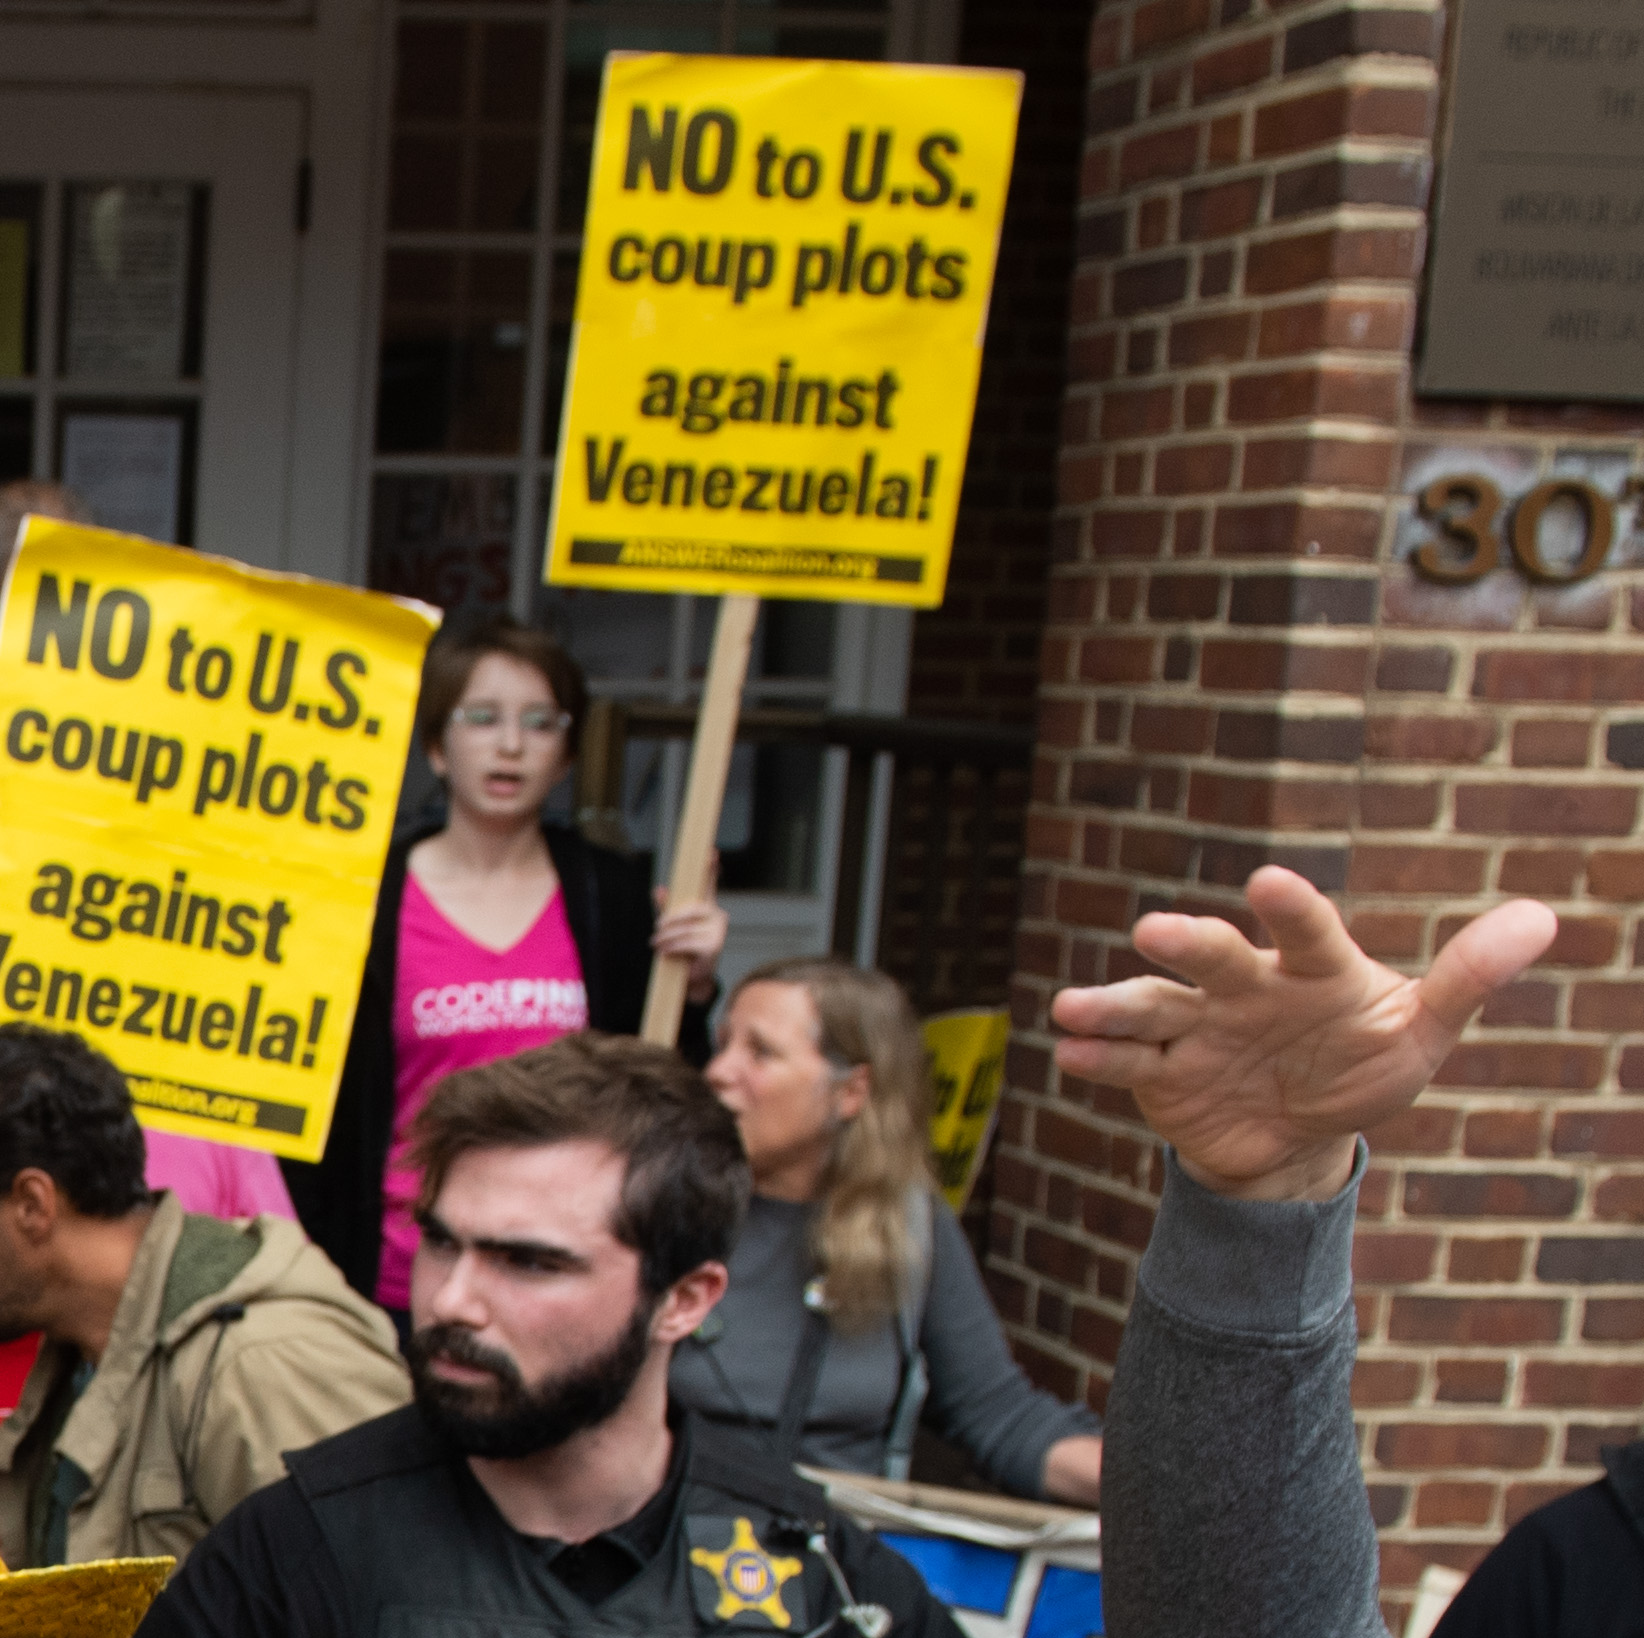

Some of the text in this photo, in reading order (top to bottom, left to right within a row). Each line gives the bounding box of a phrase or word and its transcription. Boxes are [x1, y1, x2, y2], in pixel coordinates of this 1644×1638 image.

[622, 102, 977, 210] NO to U.S.
[607, 219, 969, 311] coup plots
[638, 353, 902, 436] against
[582, 433, 939, 522] Venezuela!
[26, 571, 381, 736] NO to U.S.
[6, 708, 372, 833] coup plots
[28, 861, 292, 965] against
